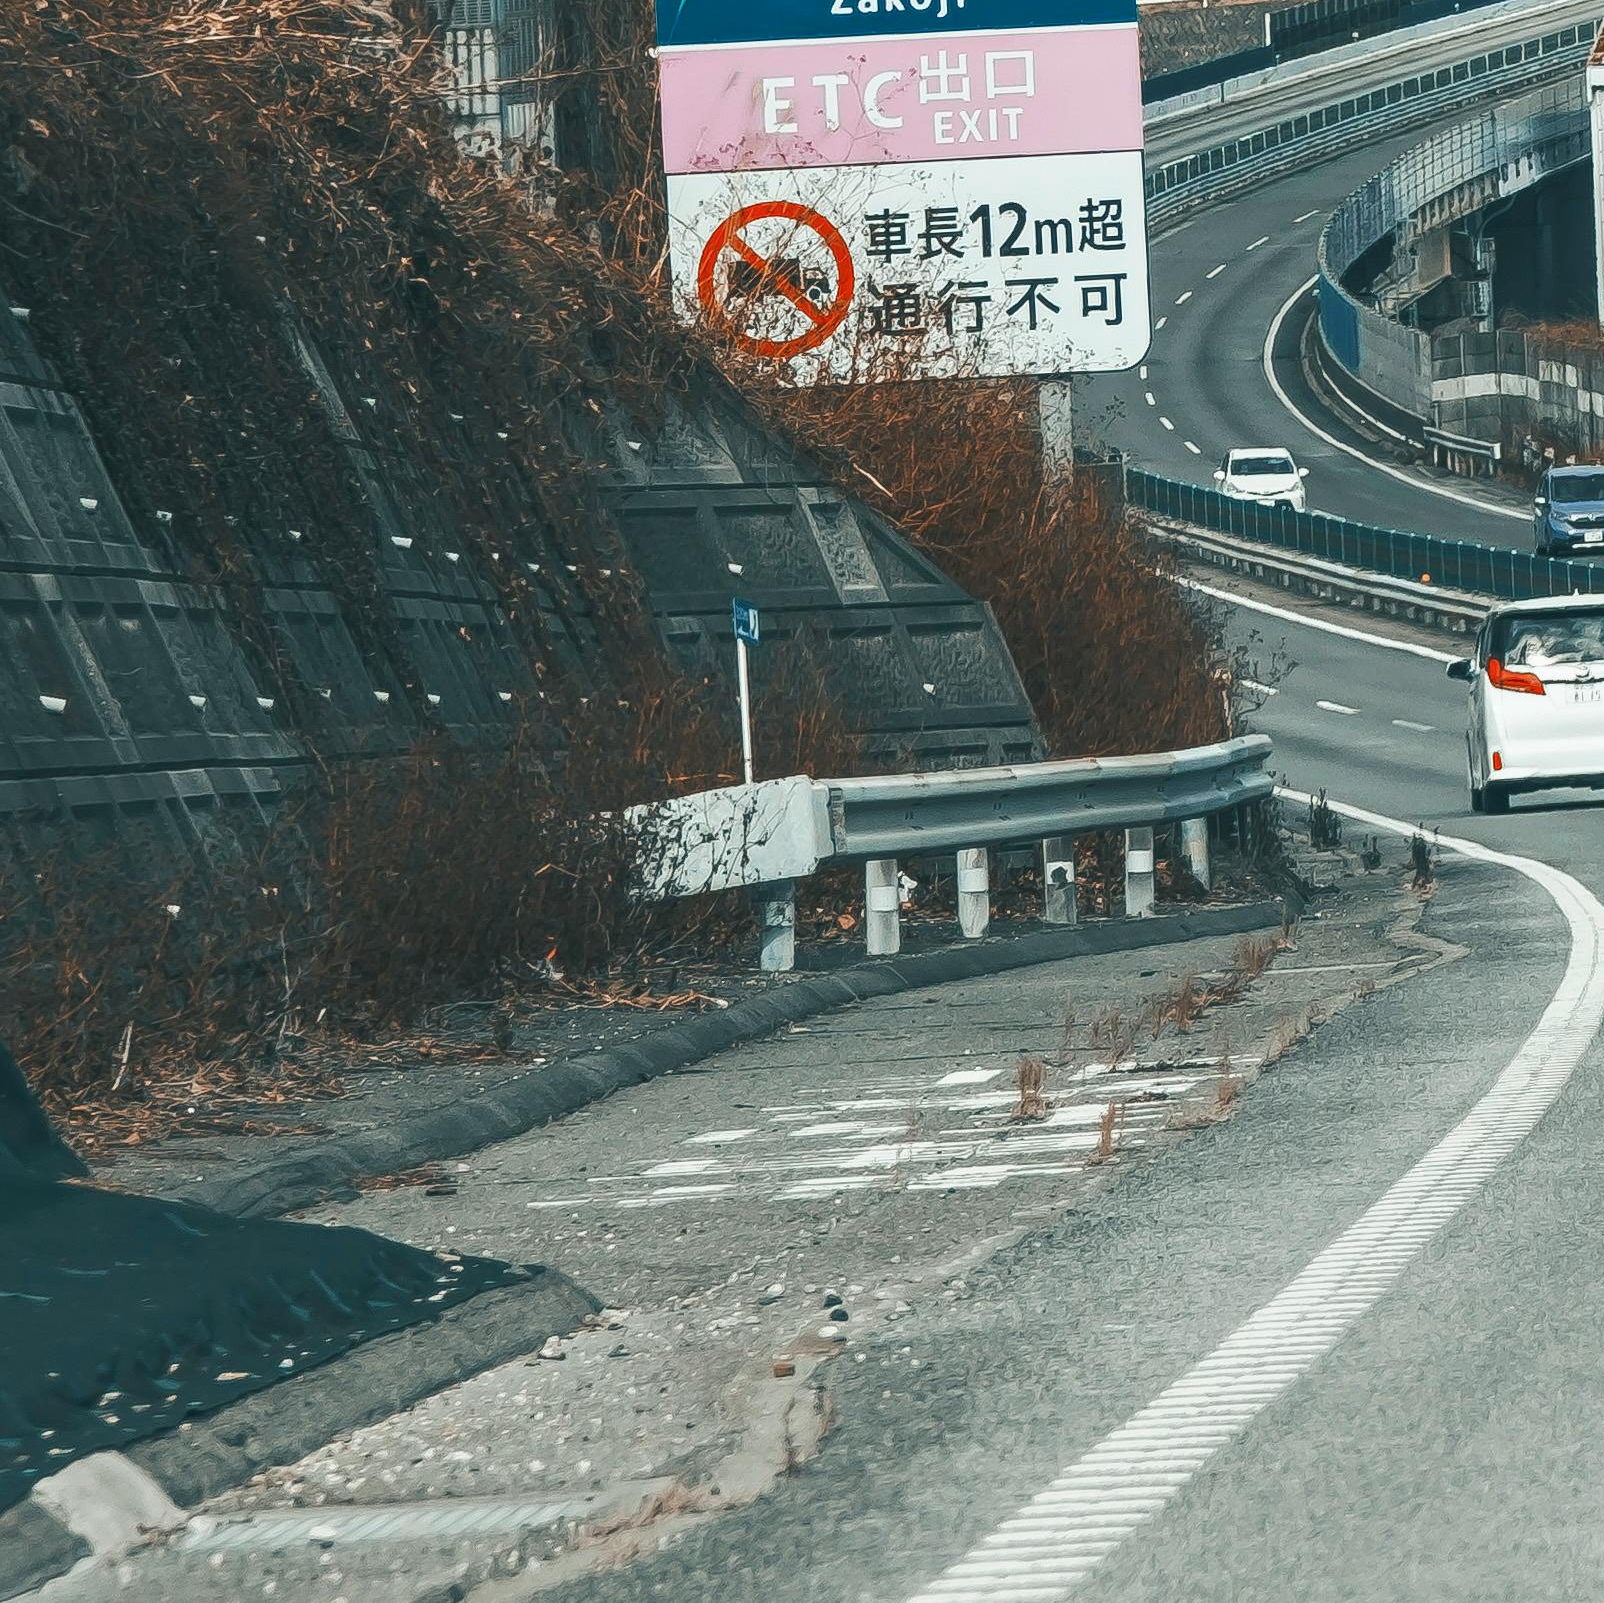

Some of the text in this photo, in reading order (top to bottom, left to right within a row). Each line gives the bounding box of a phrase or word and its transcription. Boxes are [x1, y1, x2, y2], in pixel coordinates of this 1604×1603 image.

[762, 49, 1036, 134] ETC 出口
[934, 107, 1025, 144] EXIT
[864, 197, 1127, 264] 車長12m超
[864, 272, 1128, 336] 通行不可
